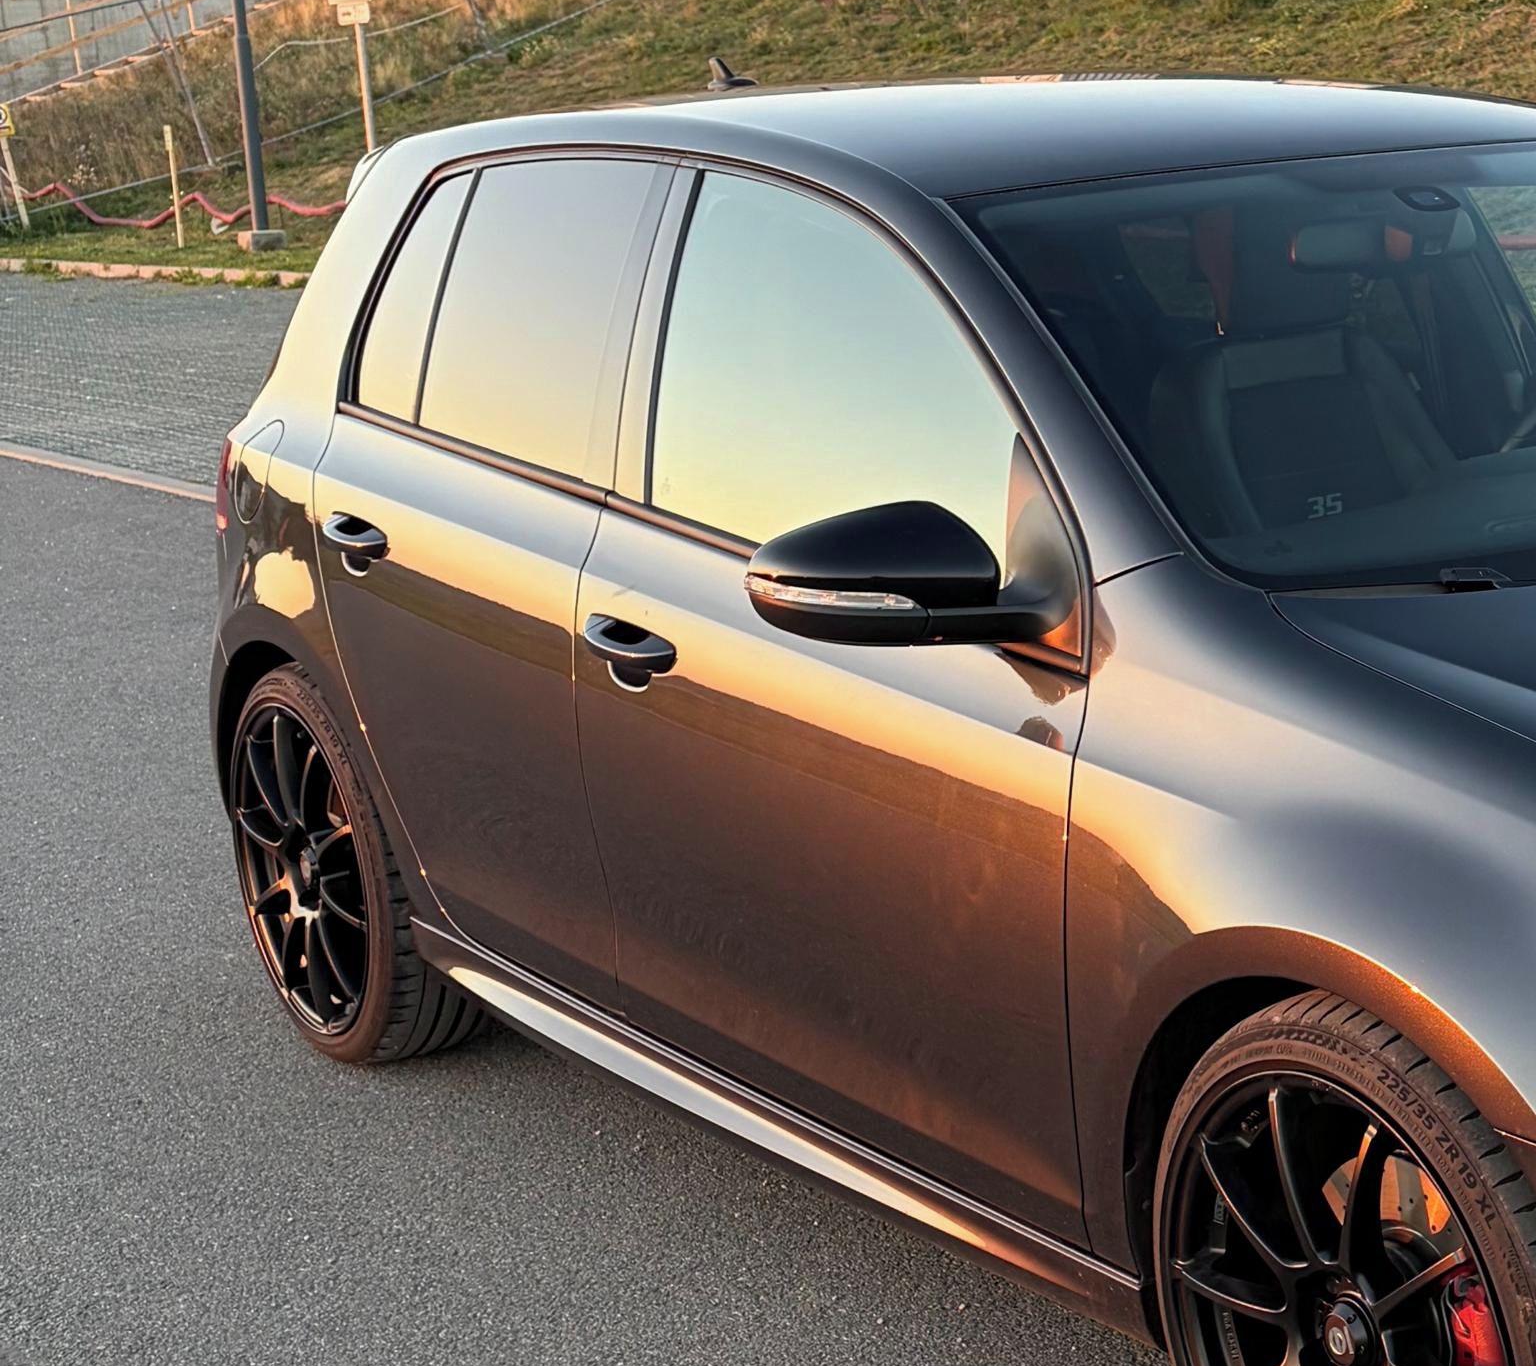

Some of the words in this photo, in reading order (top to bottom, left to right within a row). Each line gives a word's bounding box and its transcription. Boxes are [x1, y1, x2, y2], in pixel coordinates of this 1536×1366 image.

[1307, 493, 1342, 519] 35
[1376, 1068, 1437, 1131] 225/35
[1435, 1130, 1460, 1163] ZR
[1457, 1162, 1478, 1190] 19
[1475, 1194, 1498, 1230] XL
